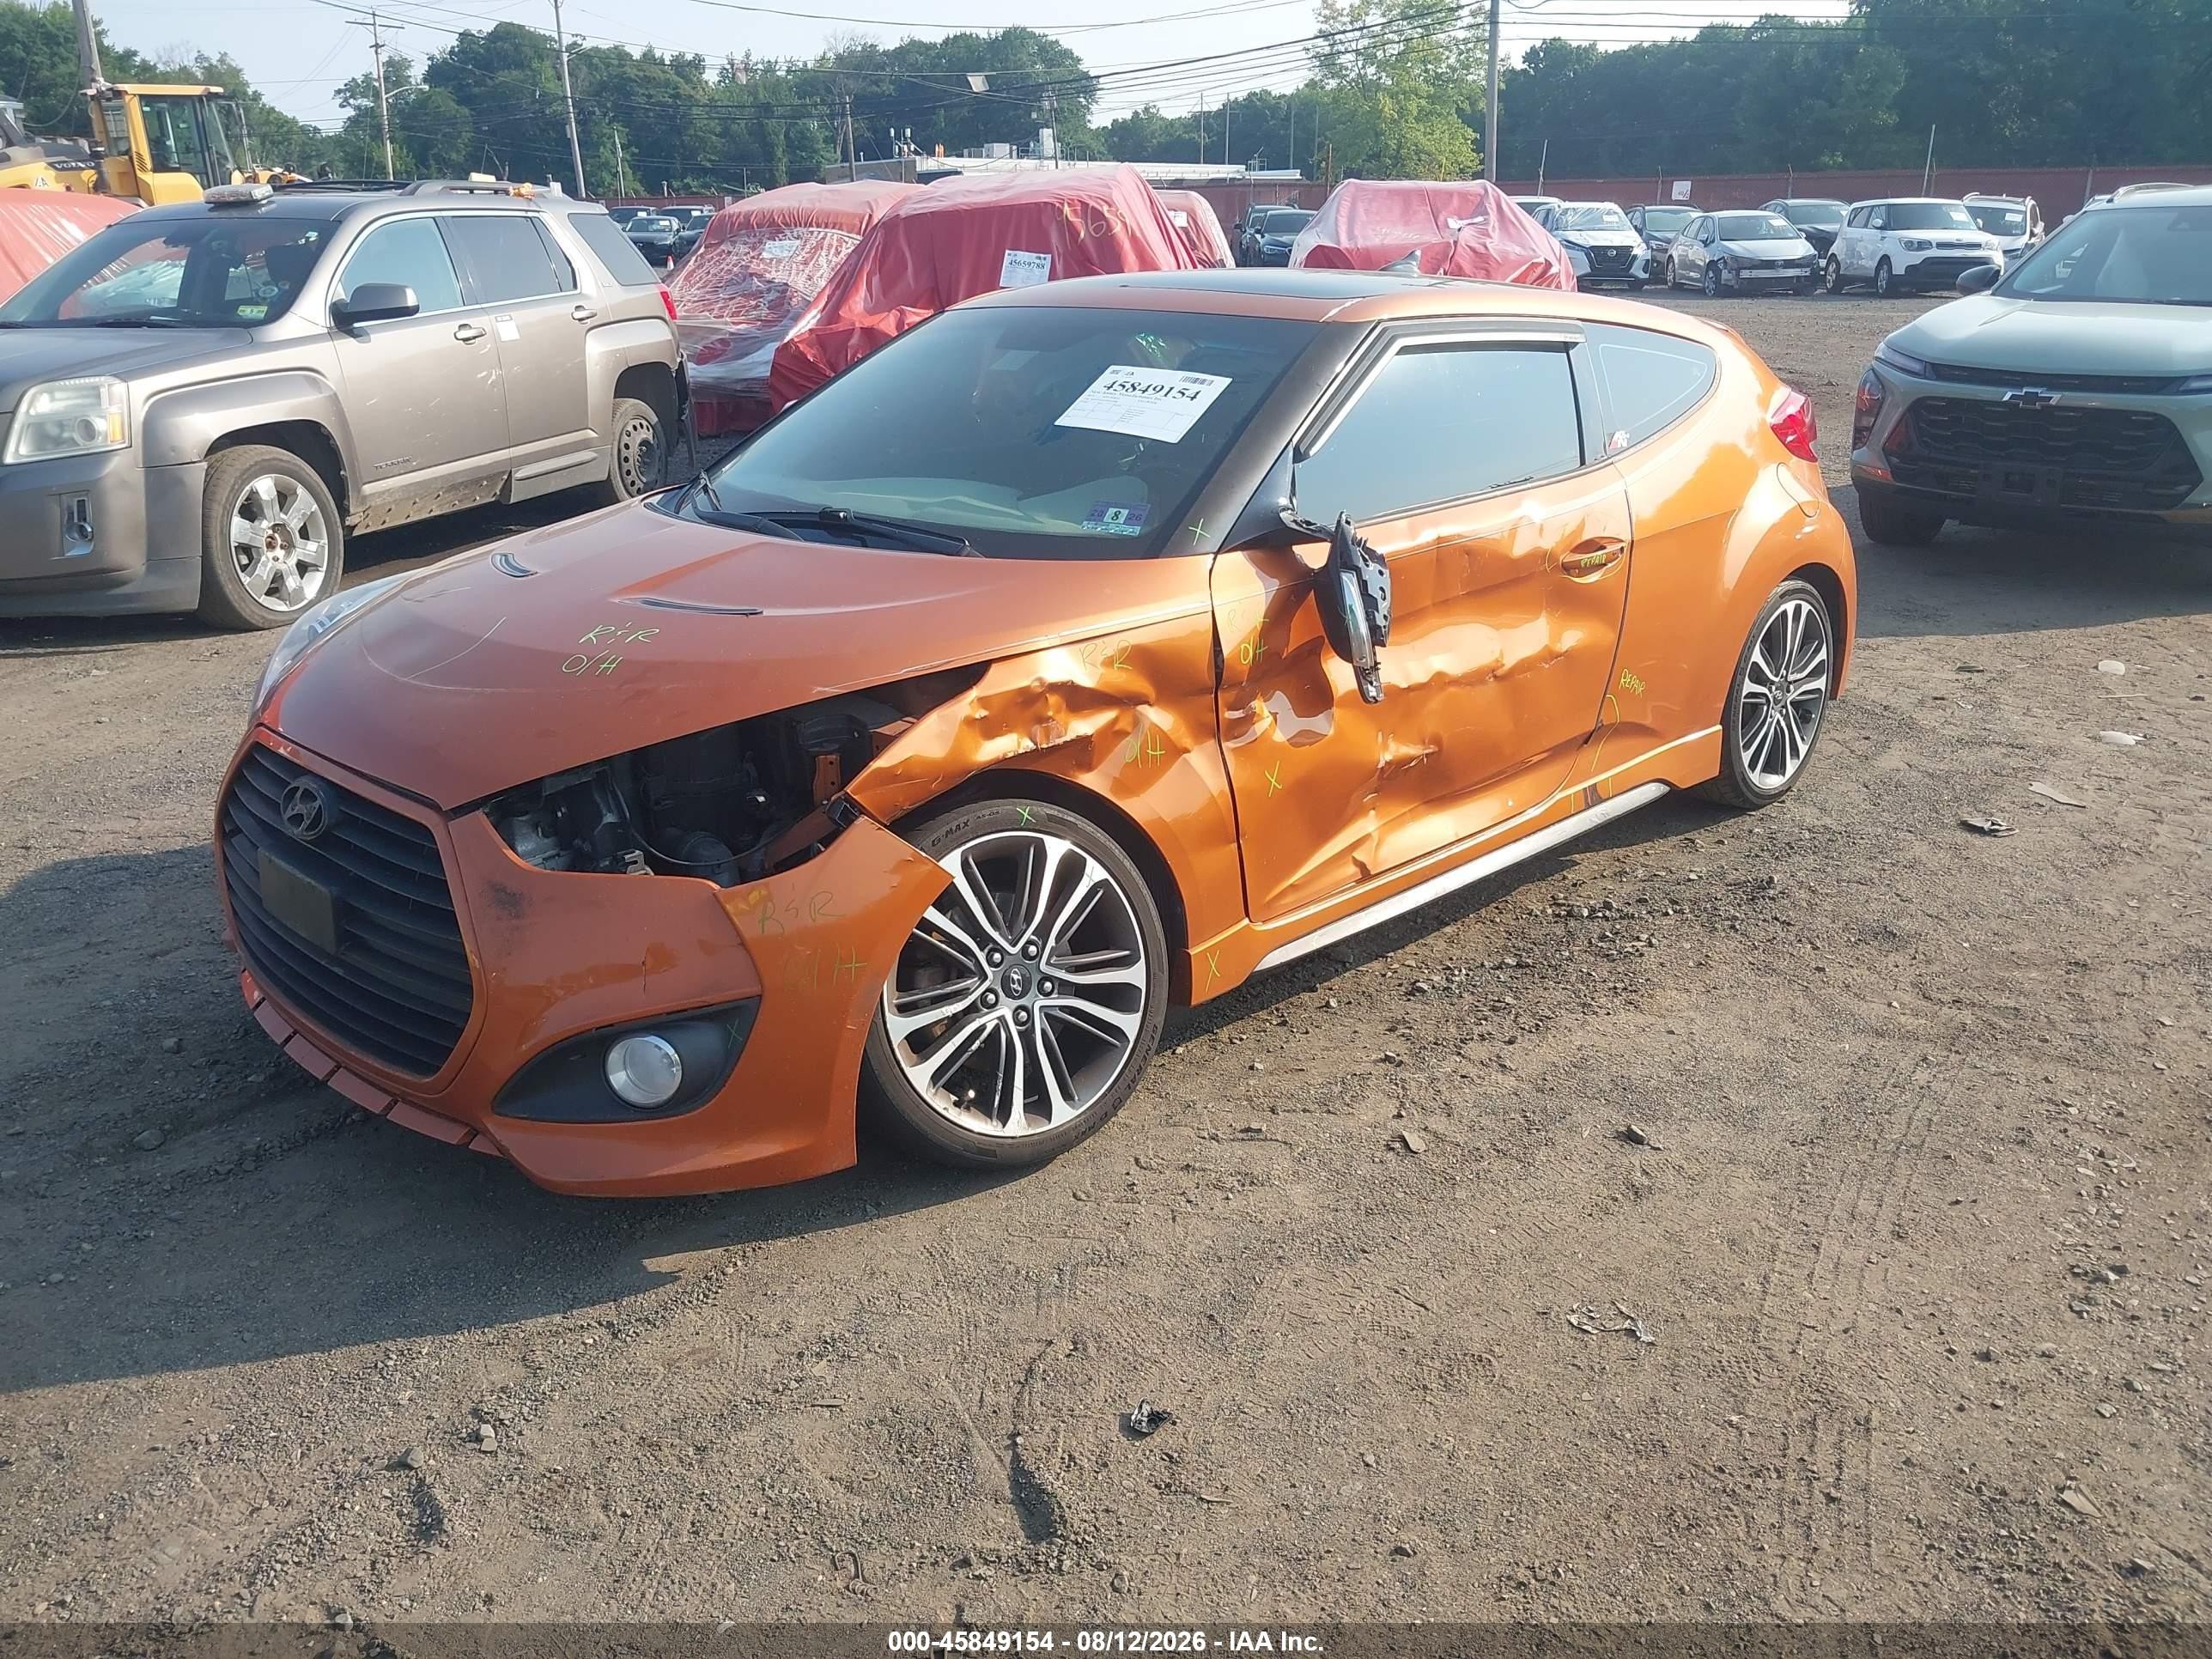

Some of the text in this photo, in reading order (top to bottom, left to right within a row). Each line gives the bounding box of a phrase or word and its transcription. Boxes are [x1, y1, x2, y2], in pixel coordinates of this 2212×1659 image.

[1007, 259, 1046, 270] 45659788
[1103, 380, 1202, 402] 45849154
[1111, 510, 1121, 521] 8
